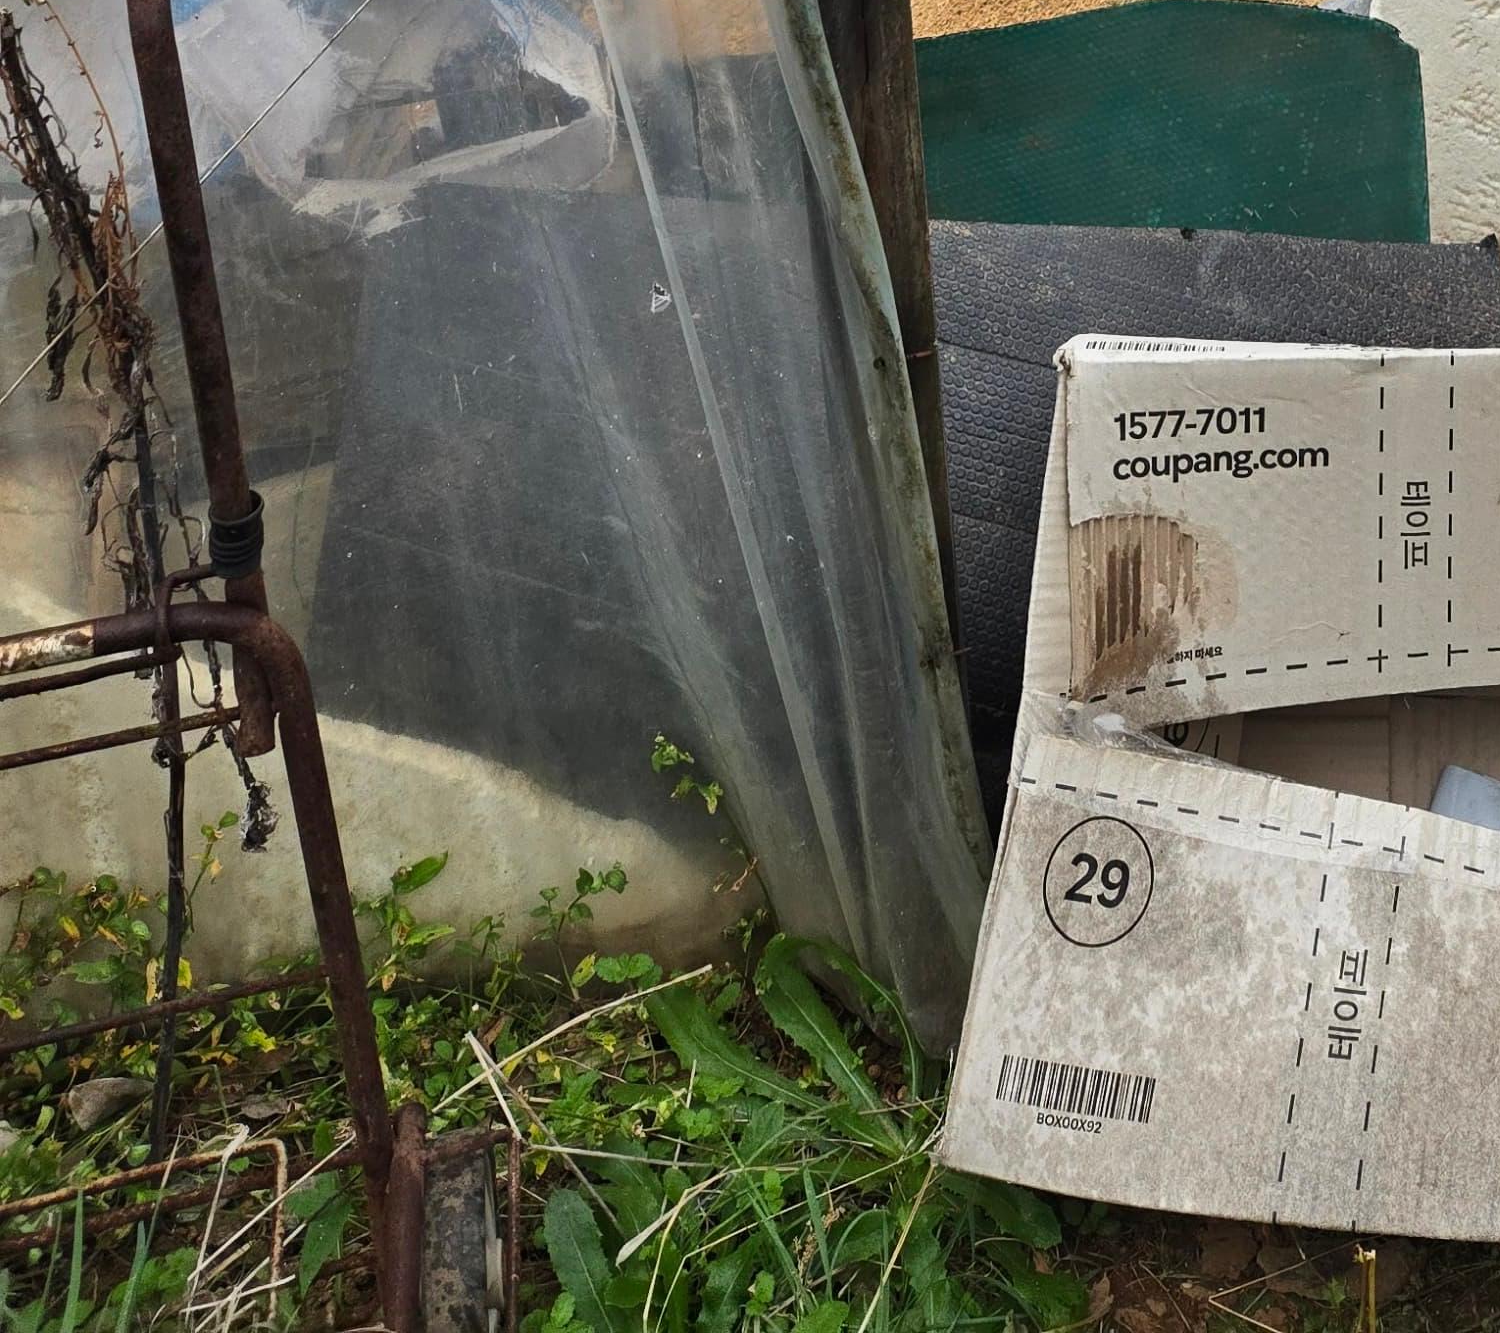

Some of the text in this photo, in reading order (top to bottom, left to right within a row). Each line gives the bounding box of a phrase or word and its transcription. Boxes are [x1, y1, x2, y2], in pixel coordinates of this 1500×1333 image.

[1113, 406, 1267, 441] 1577-7011
[1112, 445, 1330, 482] coupang.com
[1400, 480, 1431, 569] 테이프
[1195, 646, 1224, 659] 마세요
[1063, 853, 1130, 909] 29
[1327, 949, 1369, 1060] 테이프
[1036, 1112, 1102, 1134] BOX00X92
